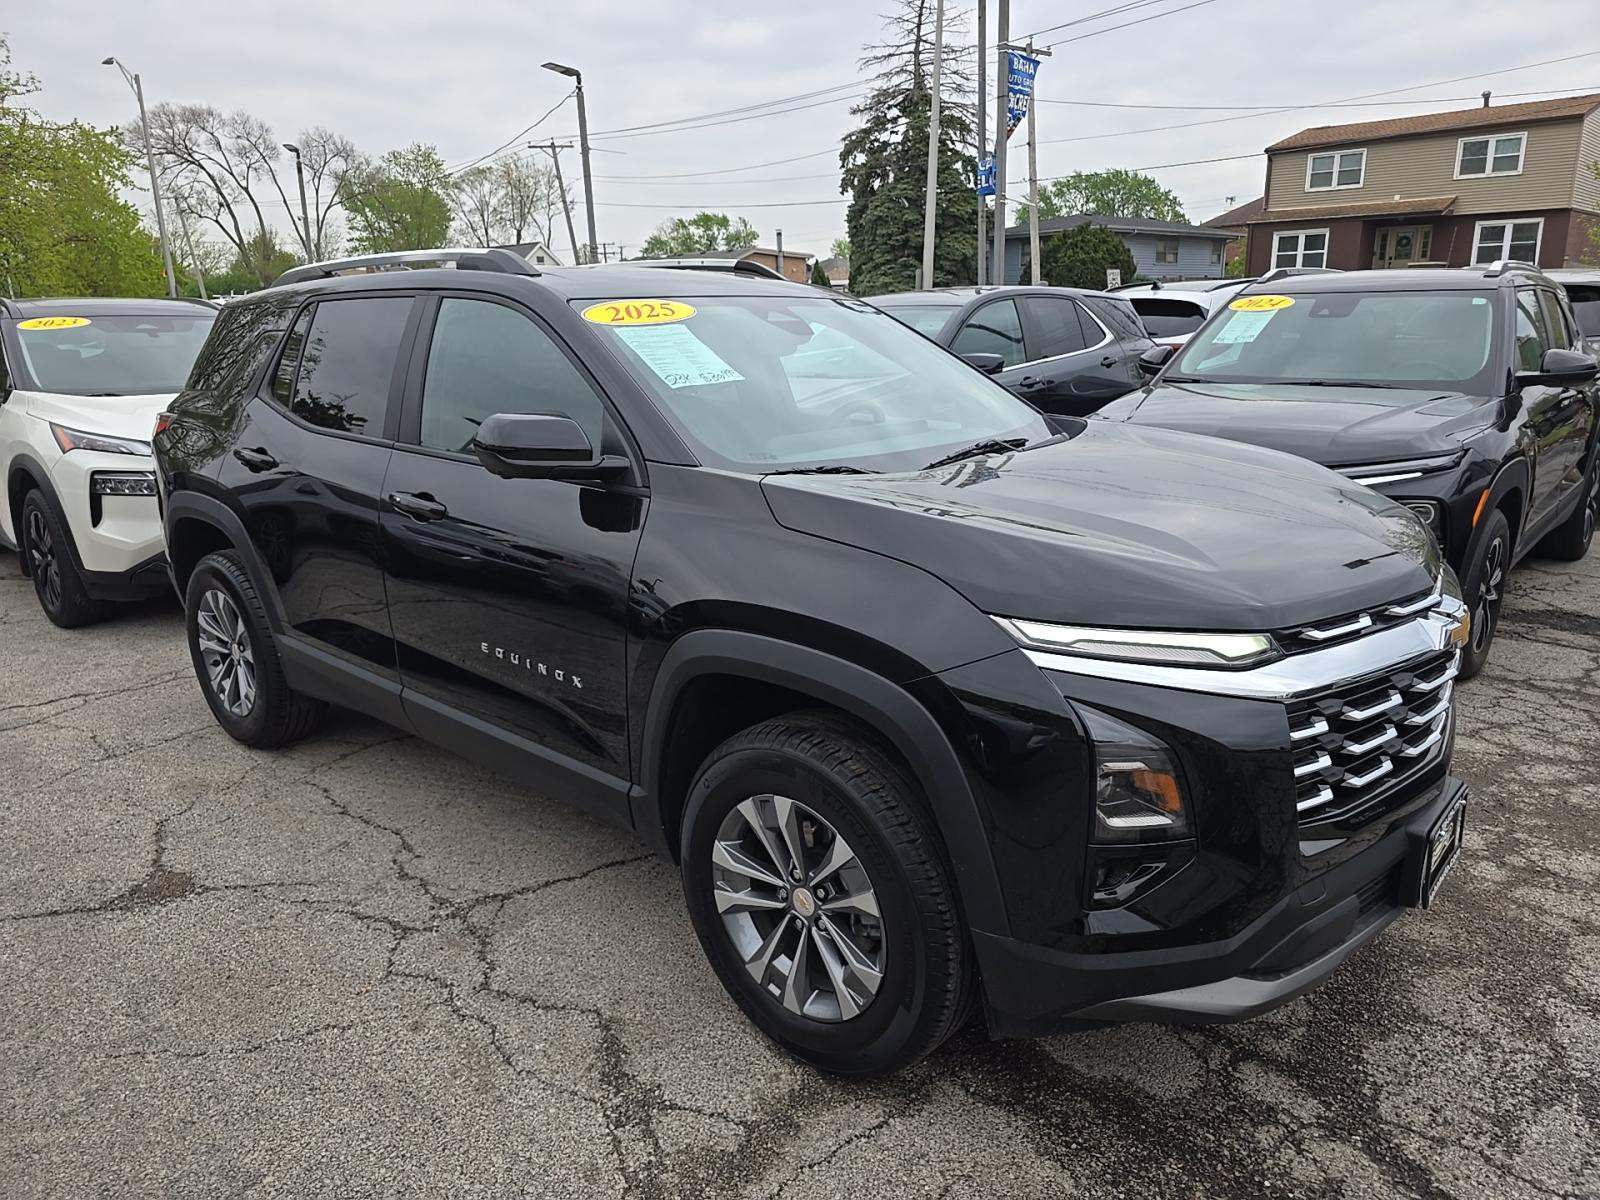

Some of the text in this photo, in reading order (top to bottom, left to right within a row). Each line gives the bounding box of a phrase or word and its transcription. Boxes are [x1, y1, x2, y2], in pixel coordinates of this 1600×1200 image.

[1013, 58, 1034, 75] BAHA
[1008, 74, 1021, 84] UTO
[606, 303, 676, 322] 2025
[481, 642, 583, 688] EQUINOX
